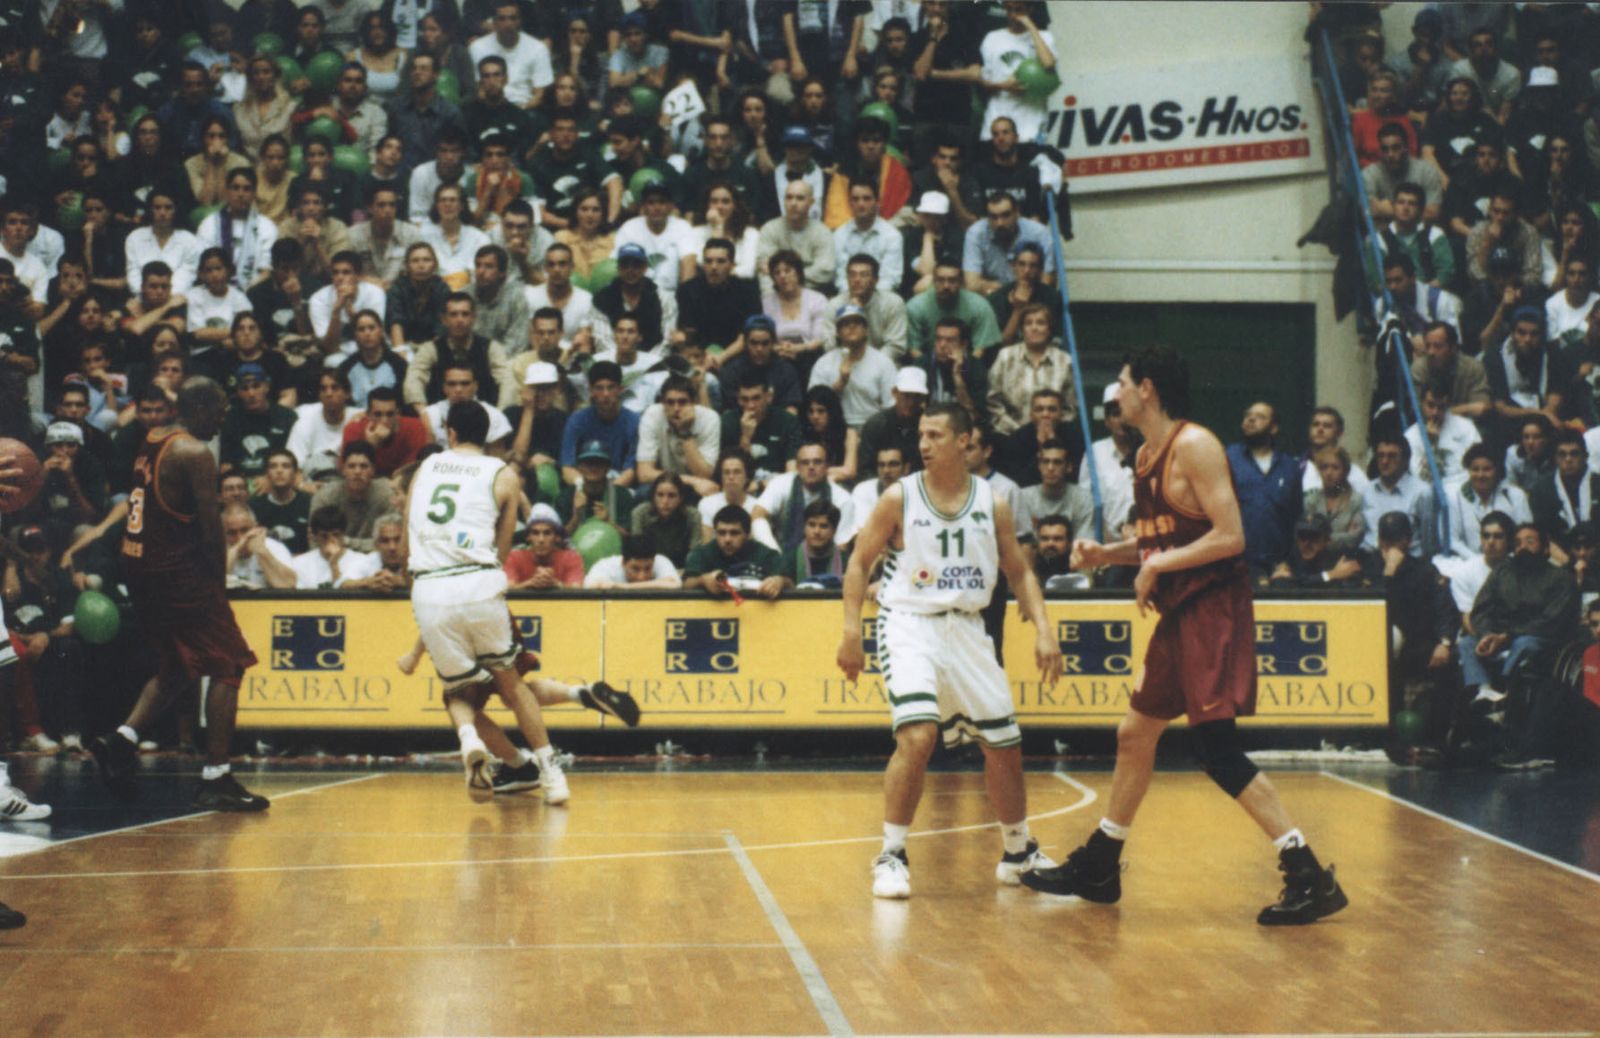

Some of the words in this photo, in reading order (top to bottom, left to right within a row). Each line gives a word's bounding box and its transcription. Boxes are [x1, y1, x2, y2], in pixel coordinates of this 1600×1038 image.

[427, 484, 461, 525] 5
[935, 528, 965, 558] 11
[942, 566, 983, 577] COSTA
[249, 676, 391, 704] RABAJO
[1010, 681, 1132, 706] TRABA
[1258, 681, 1375, 714] ABAJO
